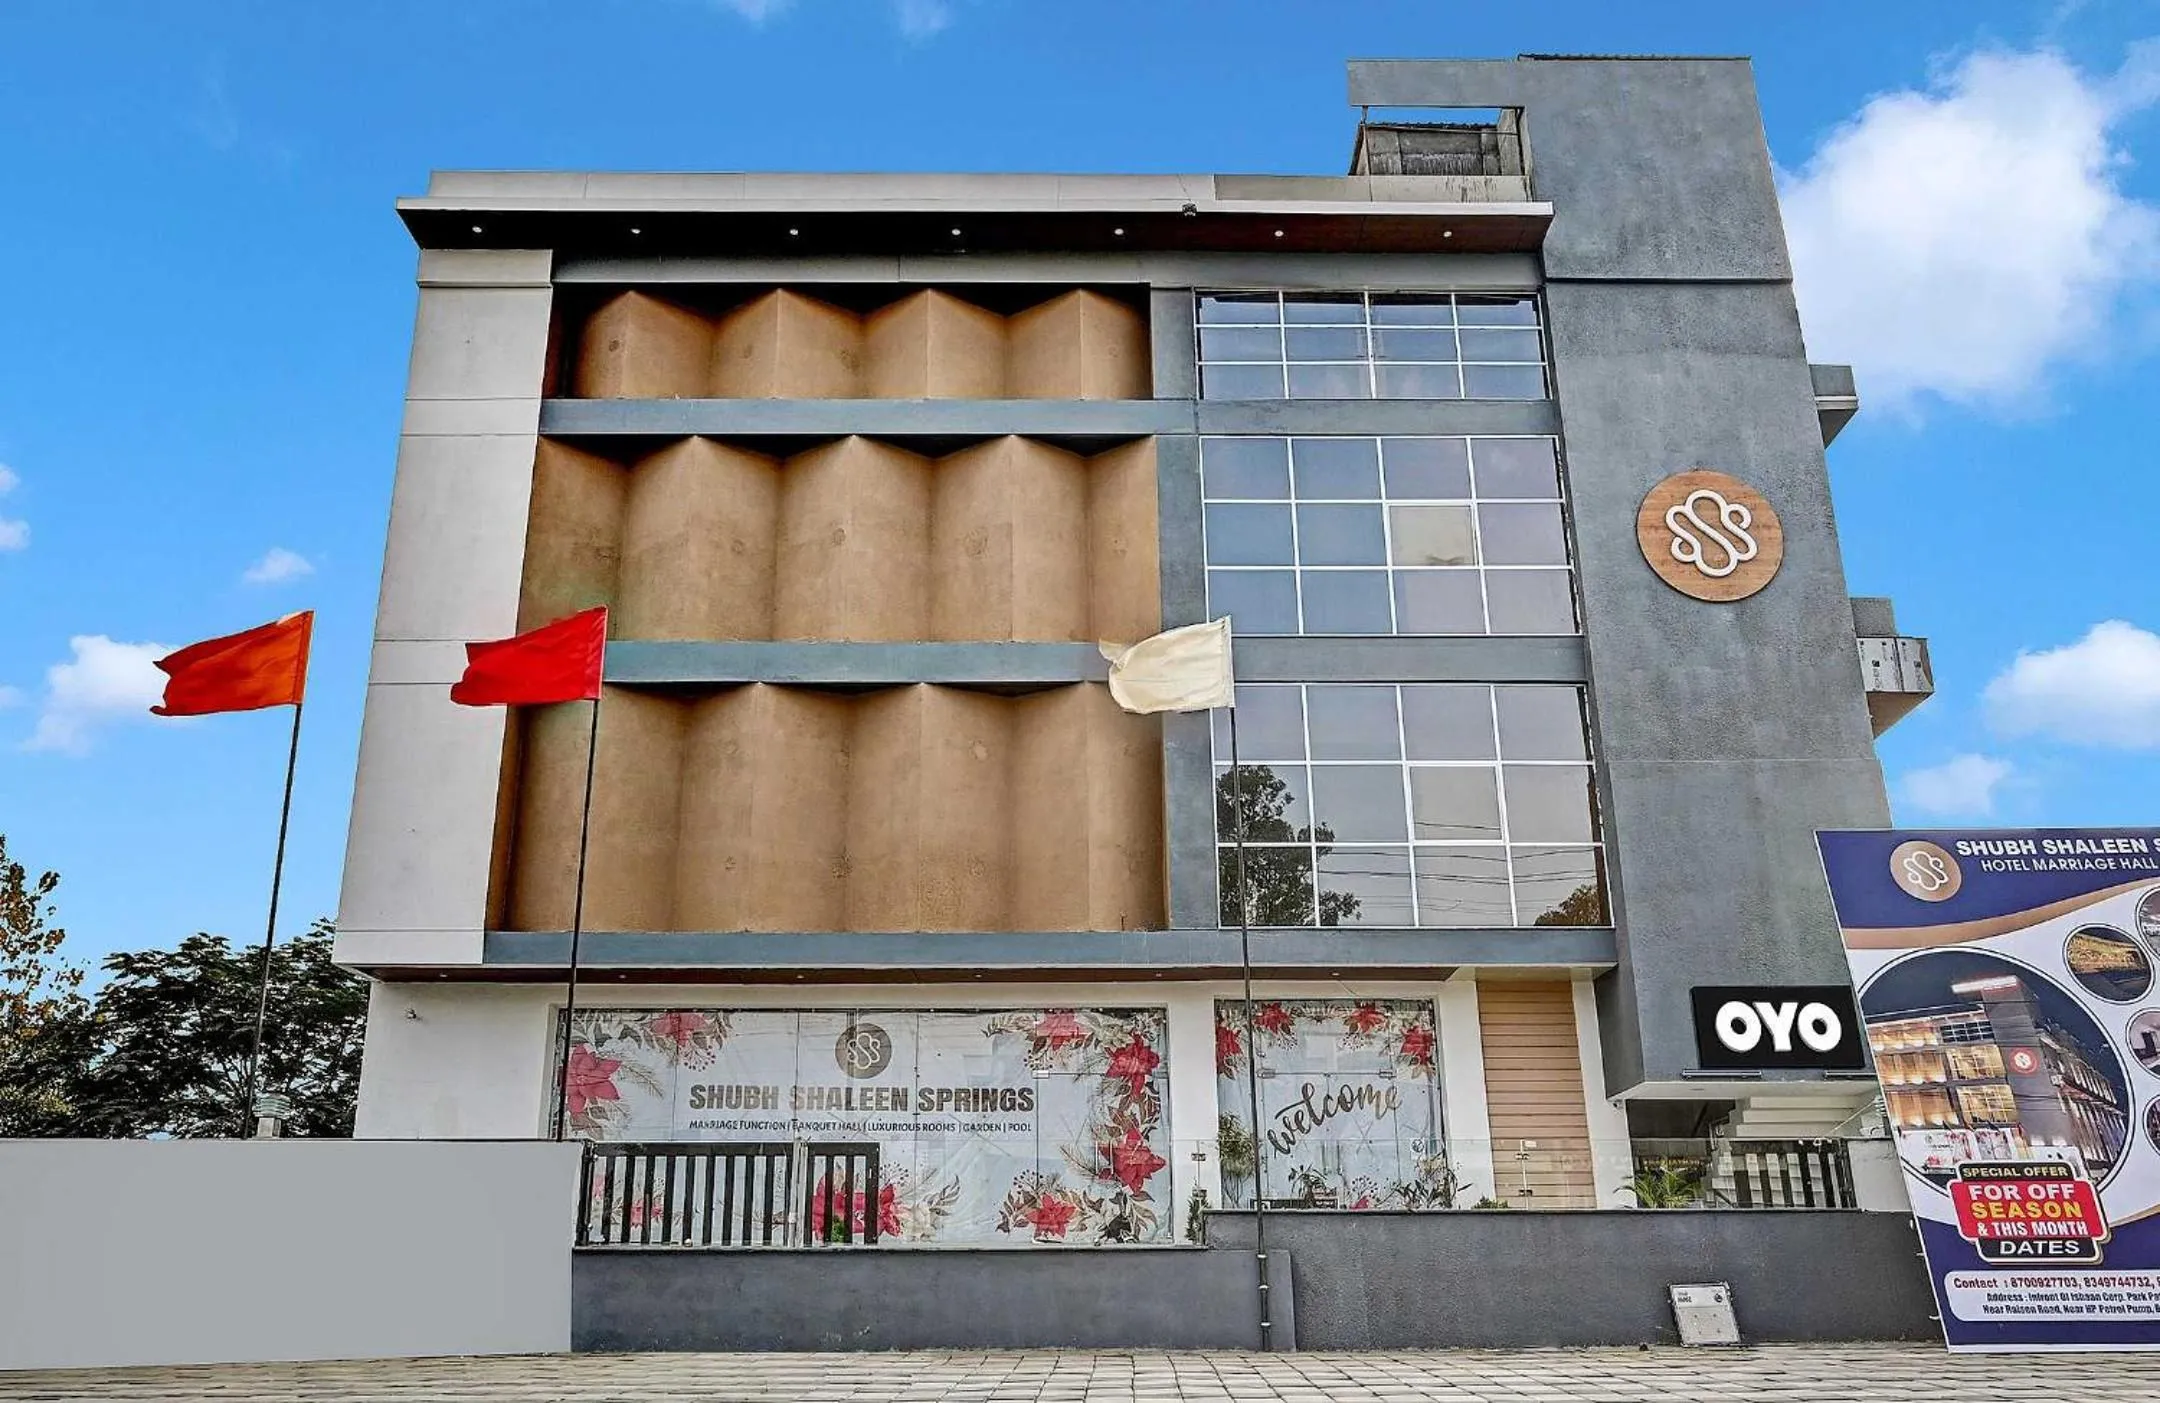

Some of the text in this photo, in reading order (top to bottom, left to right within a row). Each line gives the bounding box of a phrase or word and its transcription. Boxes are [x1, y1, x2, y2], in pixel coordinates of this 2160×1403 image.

[1956, 840, 2037, 855] SHUBH
[2041, 839, 2149, 854] SHALEEN
[1981, 857, 2158, 872] HOTEL MARRIAGE HALL
[1715, 1001, 1842, 1052] OYO
[689, 1084, 1035, 1112] SHUBH SHALEEN SPRINGS
[739, 1120, 786, 1130] FUNCTION
[867, 1122, 921, 1132] LUXURIOUS
[922, 1123, 956, 1132] ROOMS
[1267, 1082, 1402, 1155] welcome
[1963, 1167, 2068, 1177] SPECIAL OFFER
[1968, 1184, 2075, 1200] FOR OFF
[1971, 1201, 2083, 1219] SEASON
[1977, 1222, 2089, 1236] & THIS MONTH
[2000, 1240, 2080, 1254] DATES
[1953, 1277, 1998, 1289] Contact
